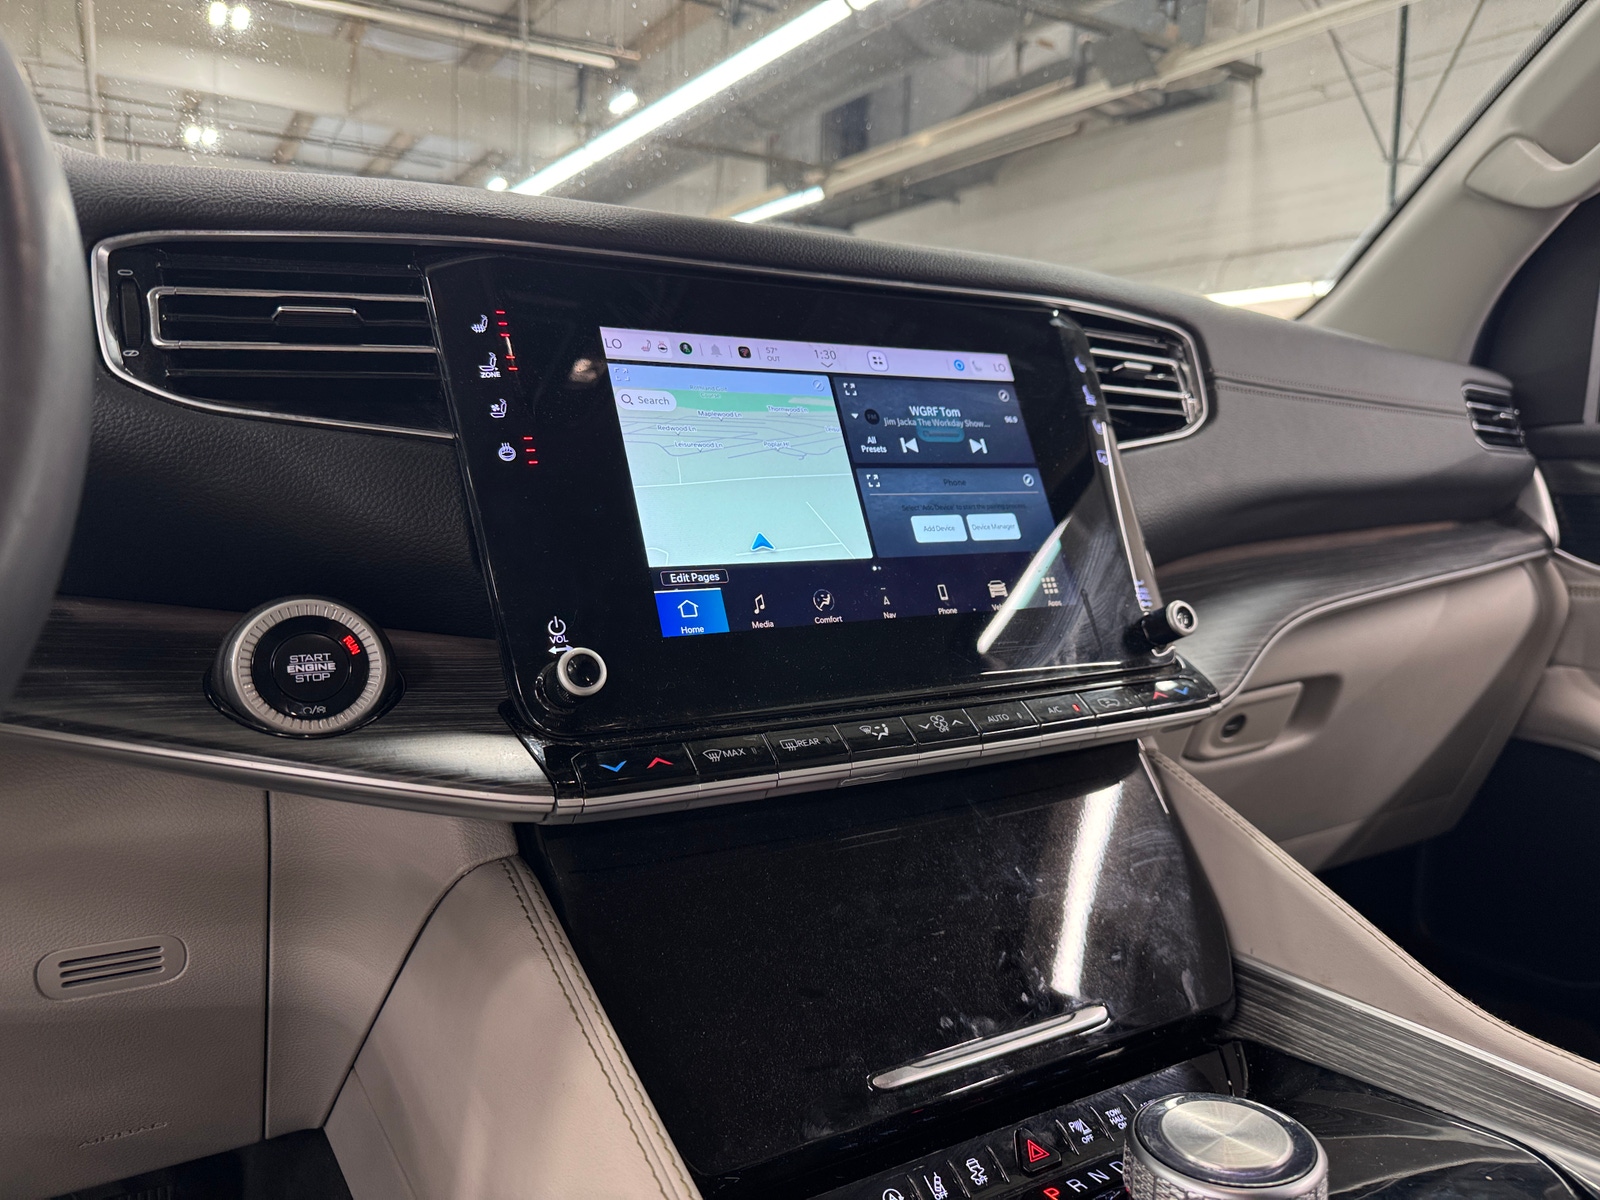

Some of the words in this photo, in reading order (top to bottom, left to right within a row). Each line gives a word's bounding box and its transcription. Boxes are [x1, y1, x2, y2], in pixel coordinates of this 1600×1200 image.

[604, 338, 622, 349] LO
[814, 349, 837, 360] 1:30
[993, 363, 1006, 373] LO
[637, 395, 670, 405] Search
[697, 410, 734, 418] Maplewood
[767, 405, 802, 413] Thornwood
[909, 406, 939, 416] WGRF
[940, 407, 961, 417] Tom
[883, 417, 897, 426] Jim
[917, 418, 932, 427] The
[932, 419, 964, 428] Workday
[867, 436, 876, 444] All
[861, 445, 887, 453] Presets
[943, 478, 966, 486] Phone
[991, 523, 1016, 531] Manager
[670, 573, 690, 583] Edit
[691, 572, 720, 583] Pages
[883, 611, 896, 619] Nav
[938, 606, 958, 615] Phone
[752, 620, 774, 629] Media
[814, 615, 843, 624] Comfort
[681, 626, 704, 634] Home
[549, 635, 569, 644] VOL
[342, 635, 361, 656] RUN
[289, 653, 331, 663] START
[287, 662, 336, 674] ENGINE
[295, 672, 330, 683] STOP
[1048, 706, 1062, 714] A/C
[987, 714, 1010, 723] AUTO
[798, 737, 821, 748] REAR
[722, 747, 746, 758] MAX
[1109, 1114, 1127, 1126] HAUL
[1081, 1133, 1094, 1144] OFF
[1066, 1178, 1088, 1193] R
[1087, 1169, 1111, 1184] N
